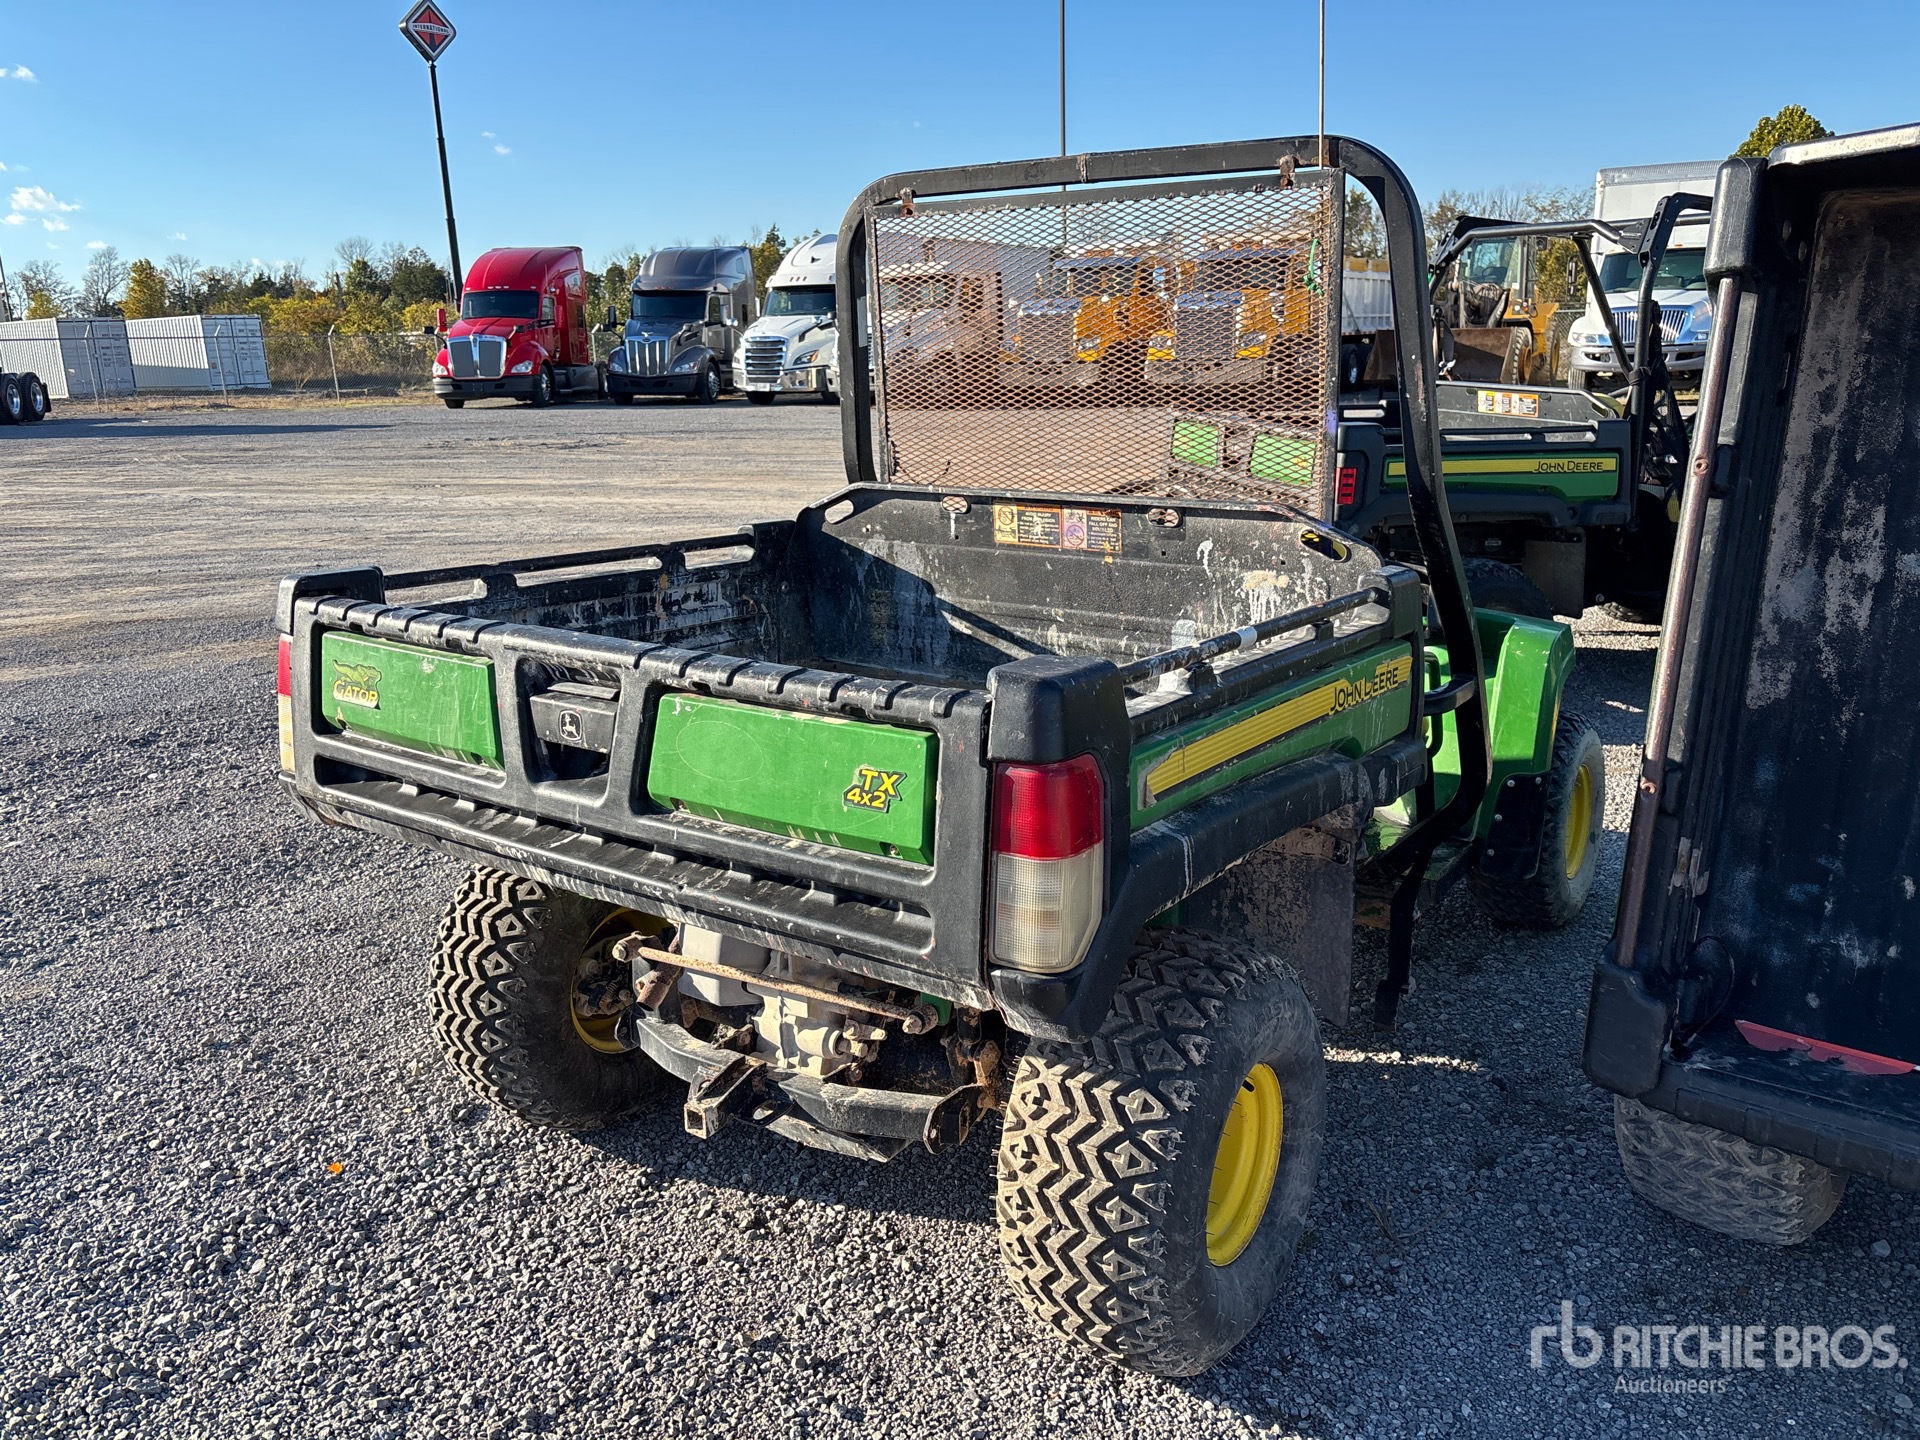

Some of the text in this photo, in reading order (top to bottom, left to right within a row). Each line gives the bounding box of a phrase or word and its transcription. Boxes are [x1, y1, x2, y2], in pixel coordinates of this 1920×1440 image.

[412, 24, 450, 33] INTERNATIONAL
[1534, 461, 1604, 471] JOHN DEERE
[333, 680, 379, 706] GATOR
[1330, 681, 1362, 712] JOHN
[861, 769, 900, 796] TX
[846, 787, 886, 809] 4x2
